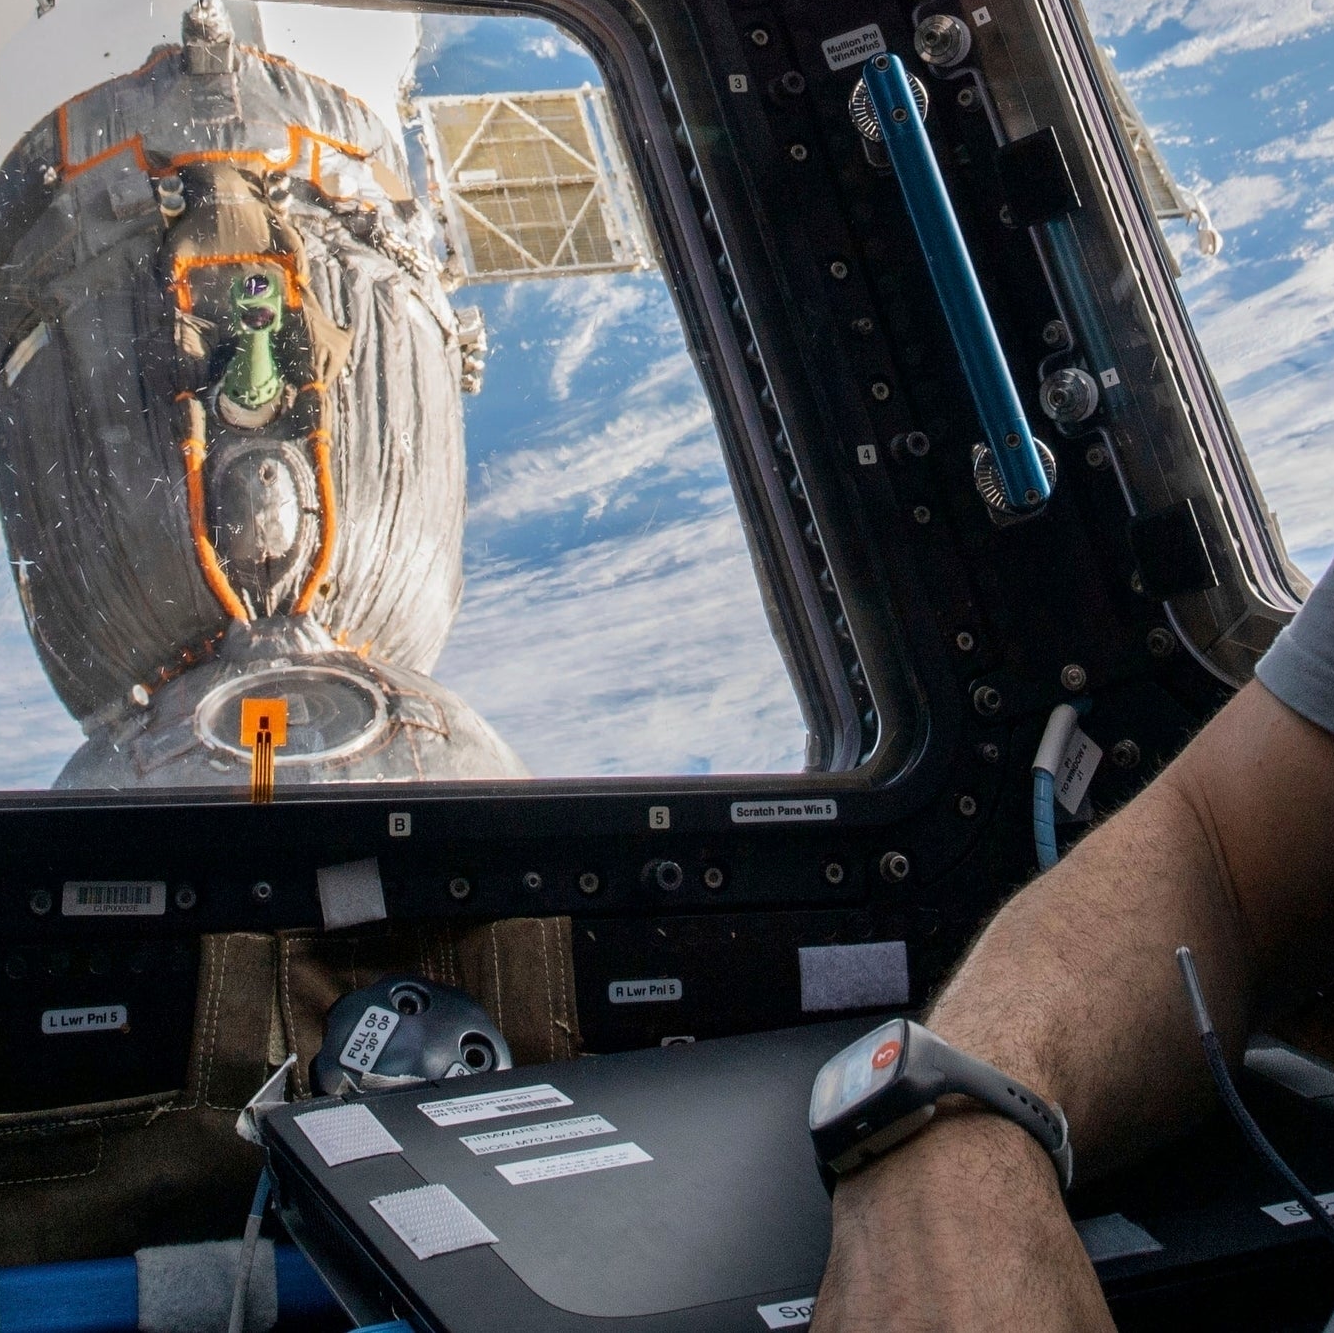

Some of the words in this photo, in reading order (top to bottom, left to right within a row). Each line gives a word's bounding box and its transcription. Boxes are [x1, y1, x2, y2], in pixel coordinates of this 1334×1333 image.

[826, 38, 861, 55] Mullion
[862, 30, 878, 42] Pnl
[831, 41, 881, 63] Win4/Win5
[734, 77, 742, 89] 3
[1060, 782, 1069, 795] TO
[656, 811, 663, 825] 5
[736, 806, 775, 818] Scratch
[778, 805, 802, 817] Pane
[804, 804, 823, 815] Win
[825, 804, 832, 815] 5
[394, 818, 405, 831] B
[616, 988, 624, 997] R
[627, 986, 647, 997] Lwr
[650, 985, 666, 996] Pnl
[669, 984, 676, 995] 5
[50, 1017, 58, 1027] L
[61, 1015, 84, 1027] Lwr
[87, 1013, 107, 1025] Pnl
[110, 1012, 118, 1023] 5
[347, 1032, 370, 1059] FULL
[365, 1013, 378, 1028] OP
[360, 1052, 370, 1066] or
[367, 1032, 379, 1052] 30°
[377, 1015, 391, 1031] OP
[877, 1048, 895, 1063] 3
[464, 1126, 536, 1143] FIRMWARE
[537, 1115, 604, 1132] VERSION
